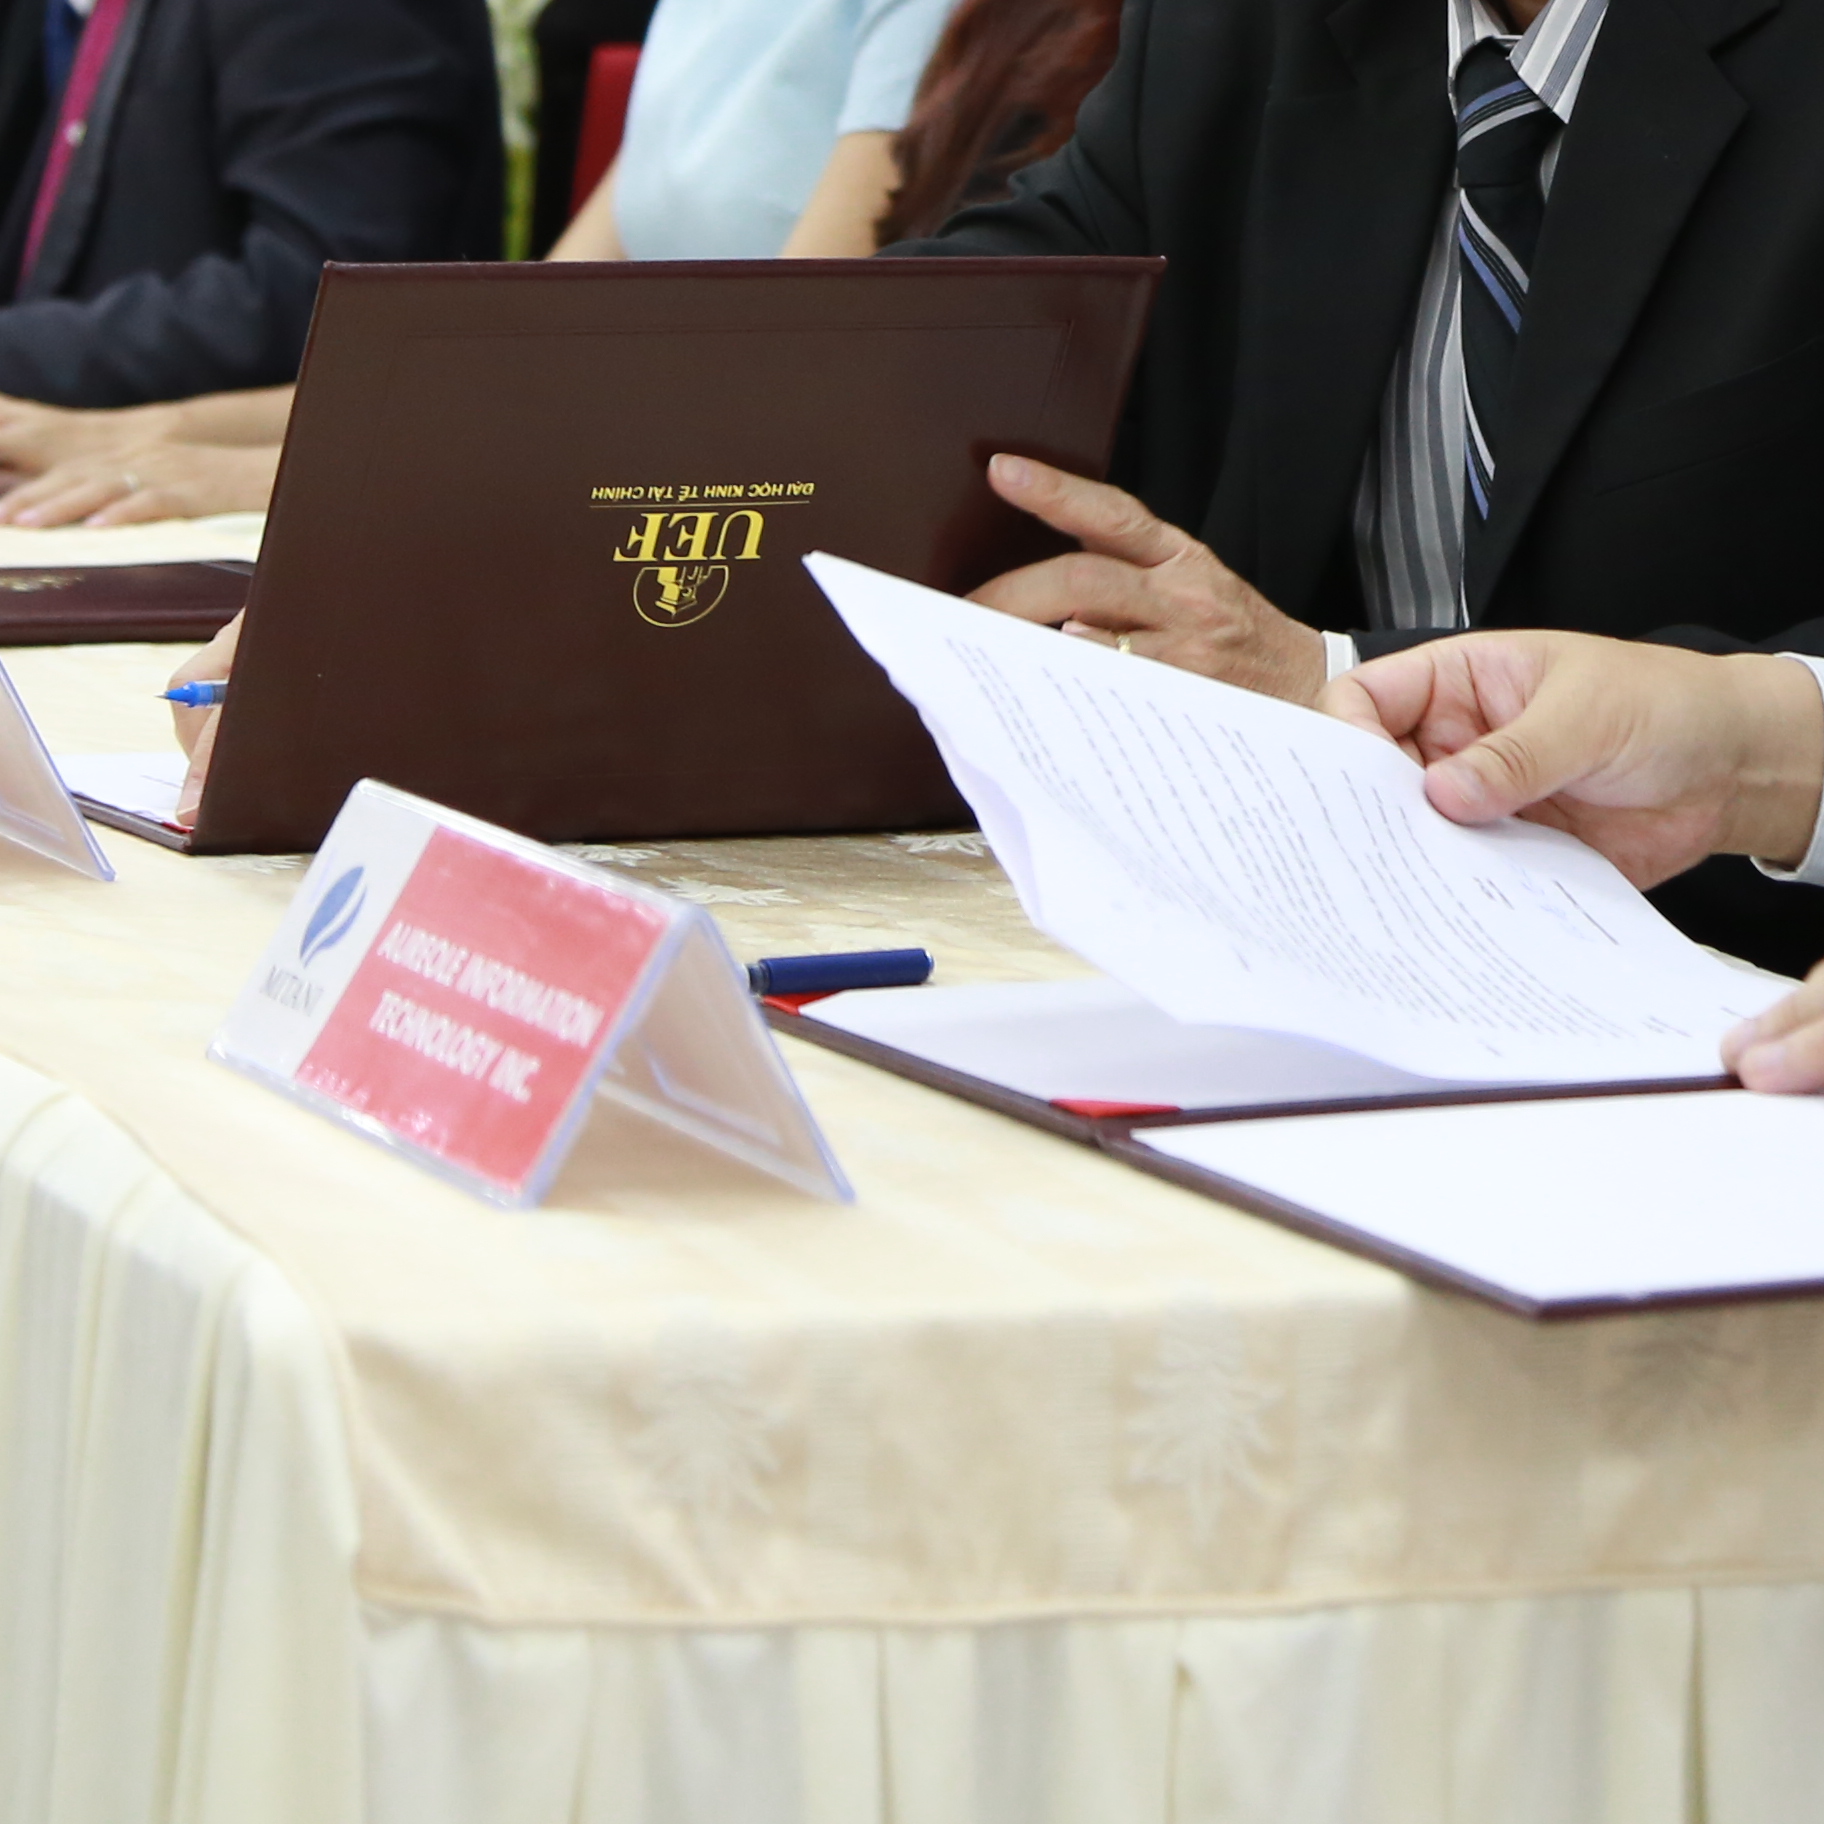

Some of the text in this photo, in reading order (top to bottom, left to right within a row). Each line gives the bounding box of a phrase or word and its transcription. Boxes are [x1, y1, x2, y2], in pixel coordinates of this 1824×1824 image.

[703, 484, 745, 498] KINH
[613, 509, 764, 562] UEF
[368, 987, 505, 1081] TECHNOLOGY
[455, 952, 606, 1049] INFORMATION
